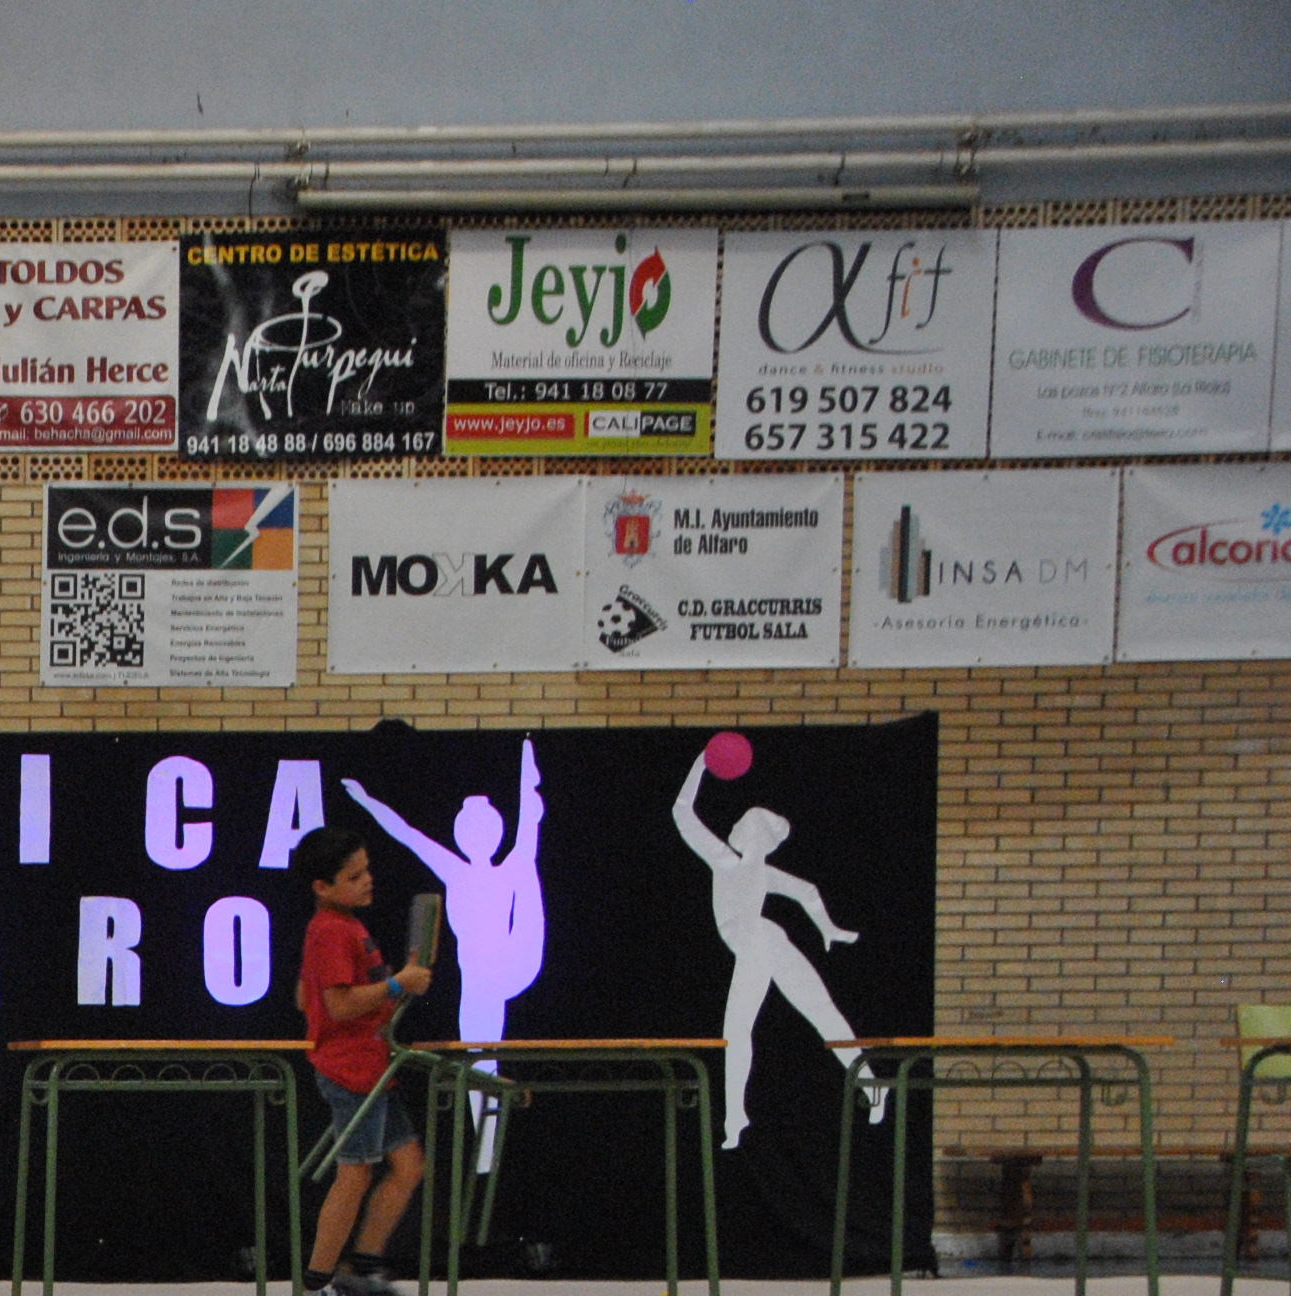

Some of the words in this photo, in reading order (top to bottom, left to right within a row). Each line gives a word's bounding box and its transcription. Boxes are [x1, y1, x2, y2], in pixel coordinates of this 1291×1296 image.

[187, 244, 283, 265] CENTRO
[289, 243, 320, 263] DE
[326, 239, 440, 262] ESTÉTICA
[1071, 234, 1195, 331] C
[3, 302, 22, 327] y
[33, 295, 168, 322] CARPAS
[491, 351, 543, 369] Material
[546, 352, 562, 368] de
[565, 350, 605, 368] oficina
[608, 355, 616, 371] y
[620, 350, 672, 372] Reciclaje
[1008, 346, 1097, 370] GABINETE
[1103, 345, 1129, 368] DE
[1138, 341, 1259, 366] FISIOTERAPIA
[87, 356, 169, 382] Herce
[758, 363, 808, 375] dance
[813, 363, 825, 375] &
[484, 382, 526, 400] Tel.:
[535, 382, 570, 400] 941
[581, 382, 604, 400] 18
[611, 382, 636, 400] 08
[644, 382, 668, 399] 77
[746, 385, 809, 413] 619
[817, 385, 880, 413] 507
[889, 385, 952, 412] 824
[20, 400, 66, 425] 630
[72, 400, 120, 425] 466
[126, 400, 167, 424] 202
[454, 413, 566, 433] www.jeyjo.es
[187, 436, 220, 455] 941
[228, 436, 250, 454] 18
[255, 435, 279, 455] 48
[284, 435, 307, 454] 88
[311, 434, 318, 454] /
[323, 434, 356, 452] 696
[361, 433, 395, 452] 884
[402, 432, 435, 451] 167
[744, 422, 807, 451] 657
[816, 422, 878, 450] 315
[887, 422, 950, 450] 422
[57, 495, 202, 550] e.d.s
[673, 508, 706, 530] M.I.
[711, 507, 819, 532] Ayuntamiento
[673, 534, 692, 555] de
[698, 533, 748, 555] Alfaro
[114, 554, 121, 563] y
[677, 598, 706, 617] C.D.
[711, 596, 823, 617] GRACCURRIS
[689, 623, 759, 641] FUTBOL
[763, 621, 808, 639] SALA
